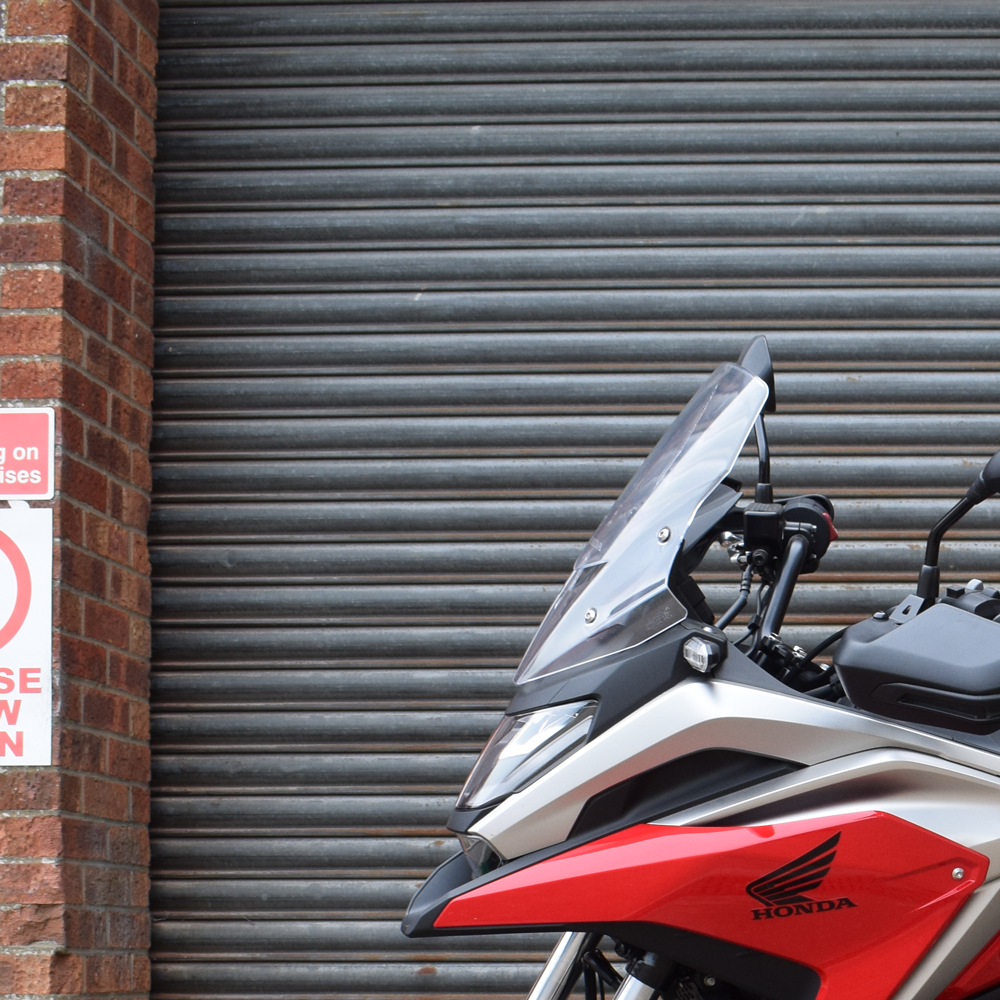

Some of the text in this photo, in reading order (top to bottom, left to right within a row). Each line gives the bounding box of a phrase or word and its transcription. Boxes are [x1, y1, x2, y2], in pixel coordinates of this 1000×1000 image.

[12, 446, 39, 460] on
[0, 466, 42, 484] ises
[0, 667, 42, 694] SE
[0, 731, 23, 757] N
[751, 897, 858, 920] HONDA
